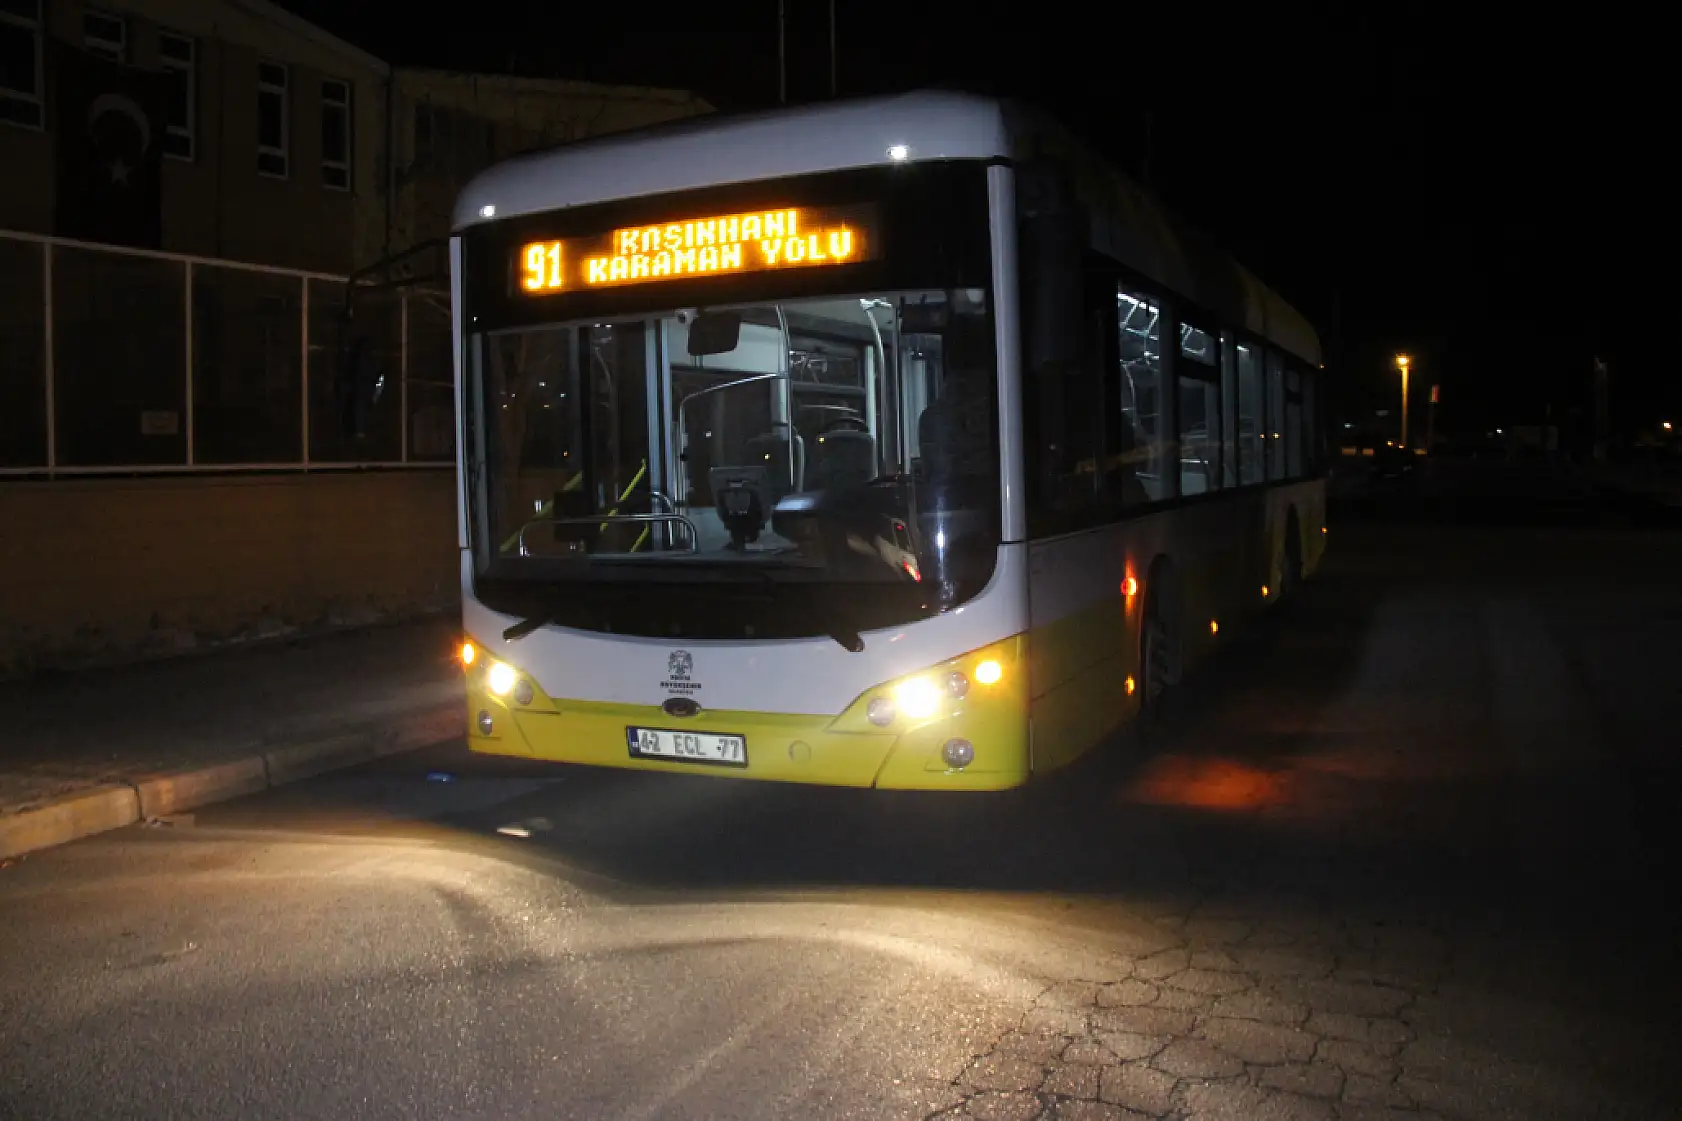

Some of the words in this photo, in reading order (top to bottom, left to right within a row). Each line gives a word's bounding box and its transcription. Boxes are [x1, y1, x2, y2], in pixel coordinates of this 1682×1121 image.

[525, 239, 564, 291] 91
[587, 242, 742, 285] KARAMAN
[759, 227, 853, 264] YOLU
[641, 731, 661, 753] 42
[673, 734, 707, 756] ECL
[718, 738, 740, 759] 77
